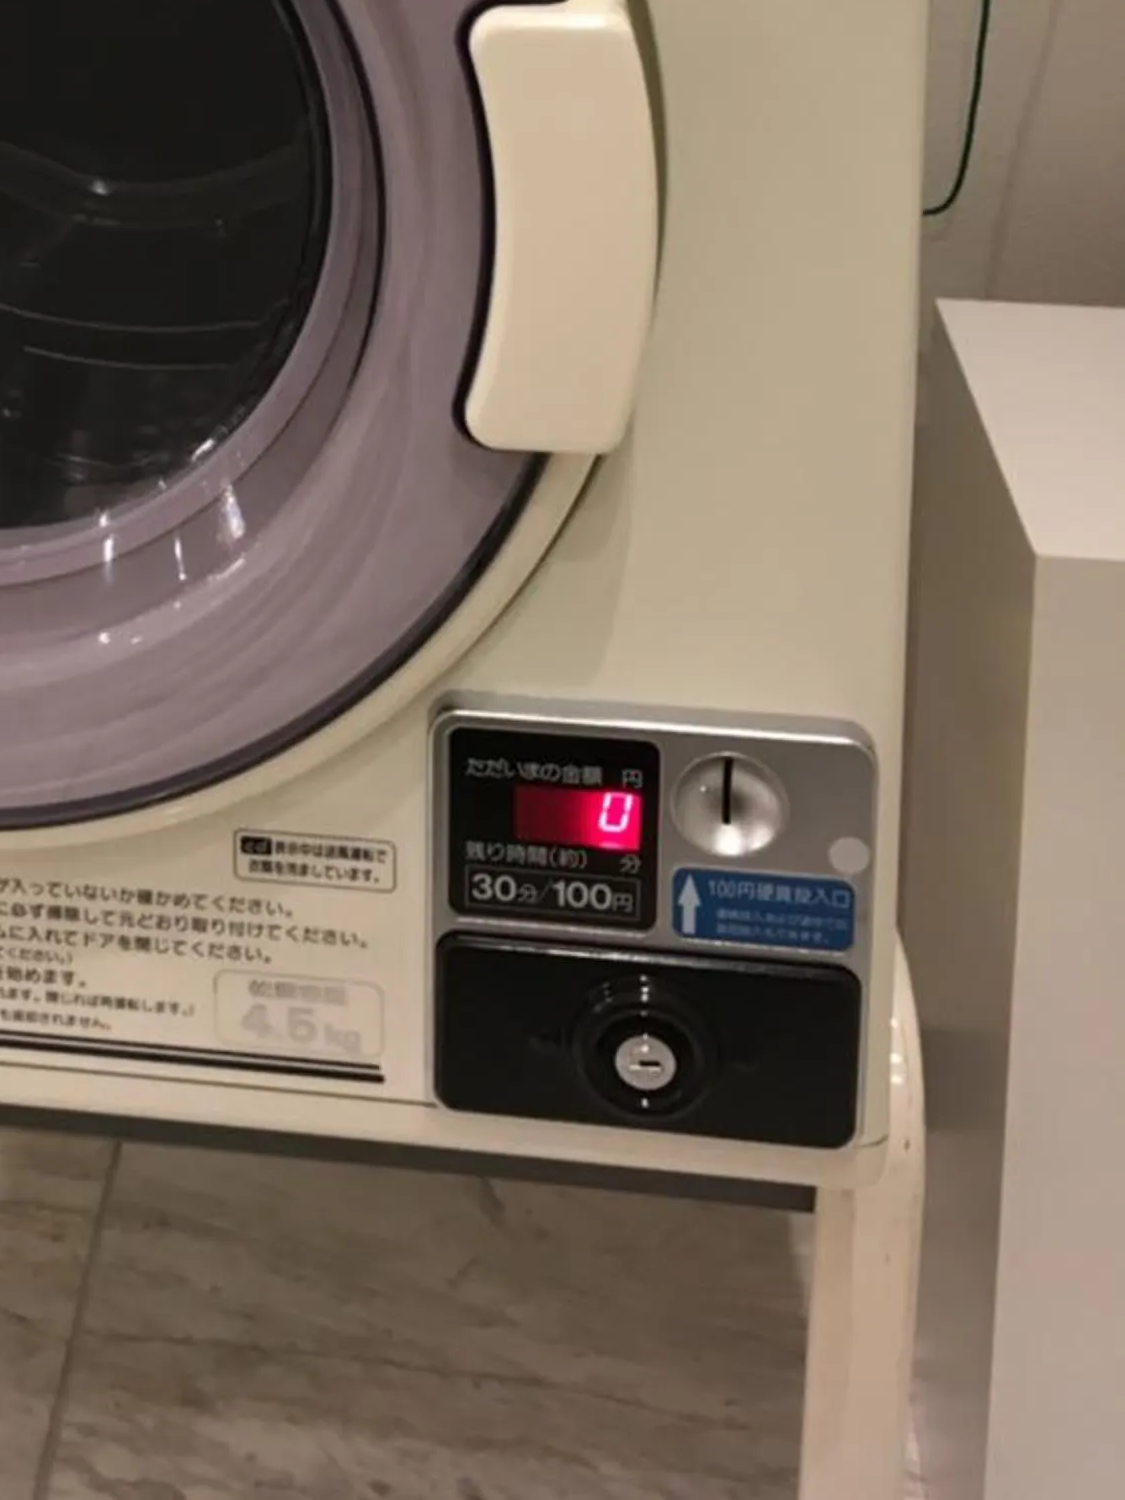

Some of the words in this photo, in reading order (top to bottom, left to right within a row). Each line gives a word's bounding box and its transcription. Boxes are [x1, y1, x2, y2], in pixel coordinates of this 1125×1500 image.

[621, 768, 644, 789] 円
[598, 791, 634, 833] 0
[619, 853, 642, 874] 分
